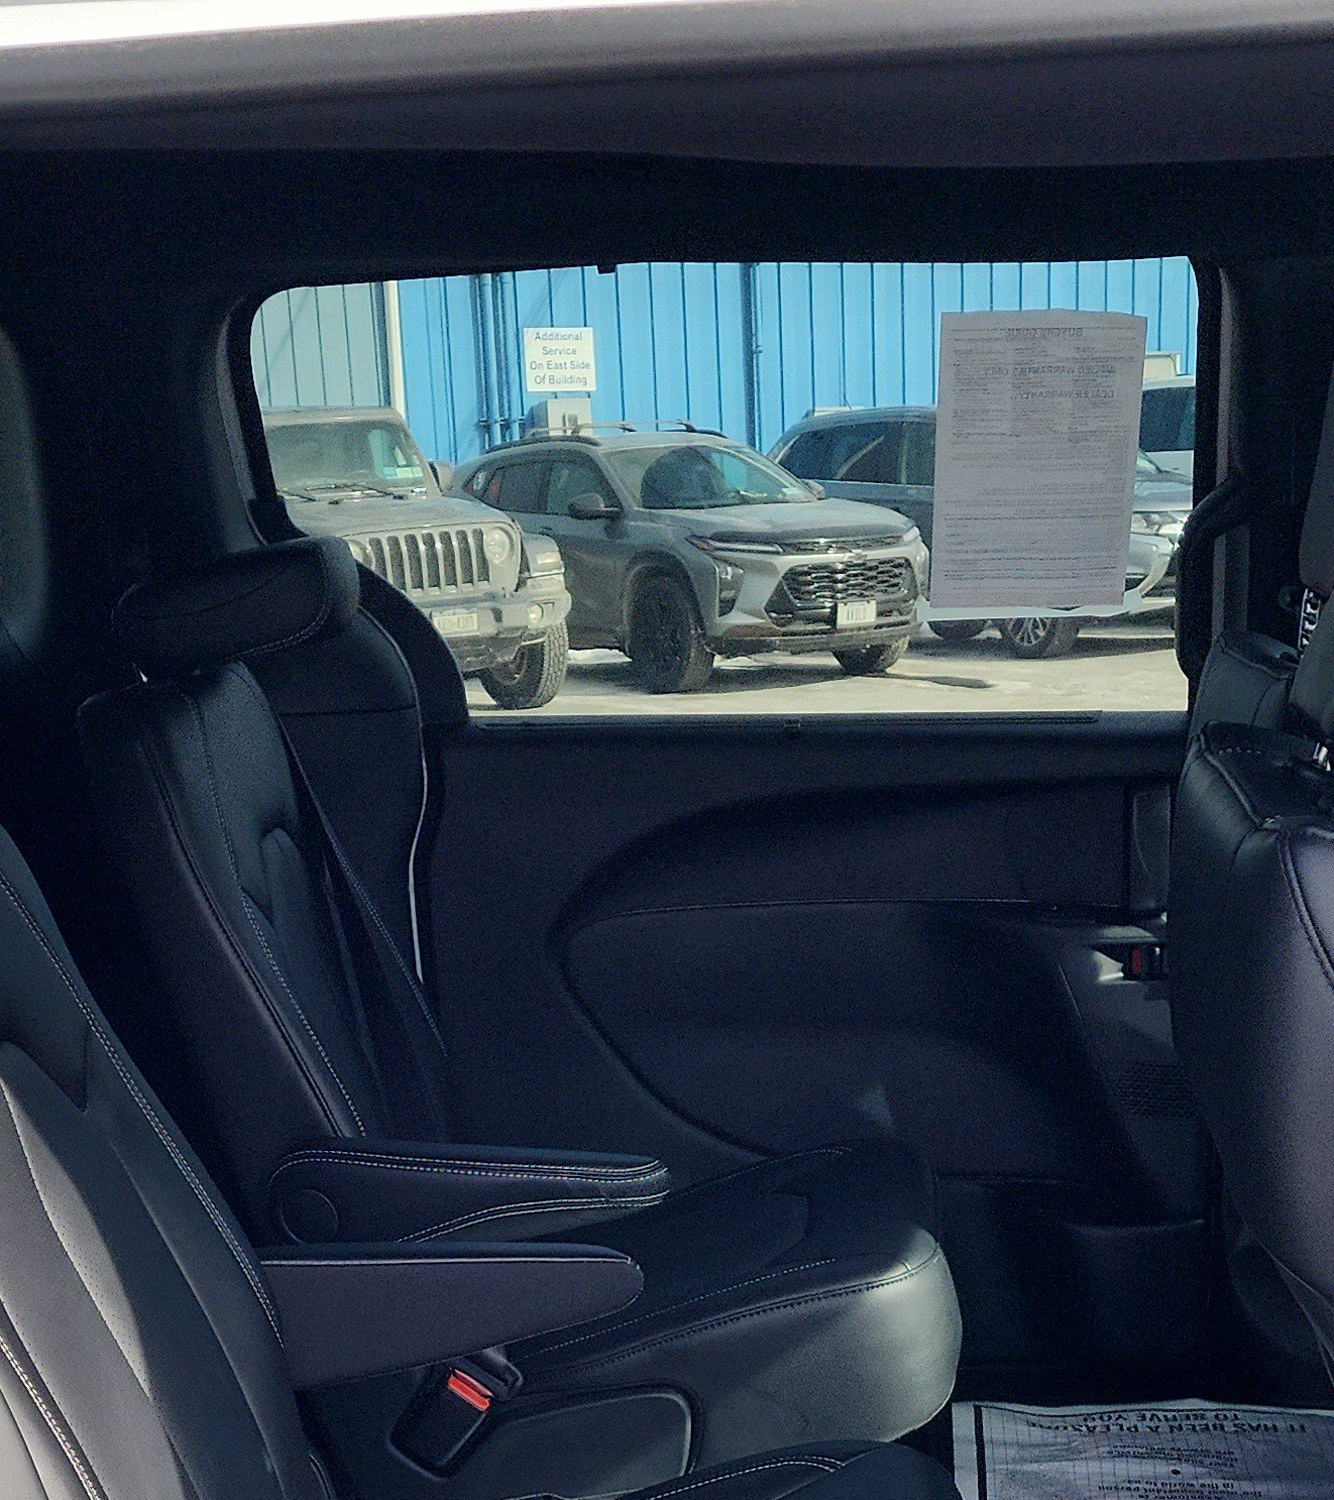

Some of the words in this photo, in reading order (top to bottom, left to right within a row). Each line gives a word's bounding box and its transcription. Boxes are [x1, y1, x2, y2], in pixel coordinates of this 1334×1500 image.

[535, 332, 583, 341] Additional
[542, 346, 577, 355] Service
[530, 361, 543, 370] On
[547, 361, 567, 370] East
[570, 361, 590, 370] Side
[535, 375, 546, 385] Of
[548, 375, 587, 386] Building
